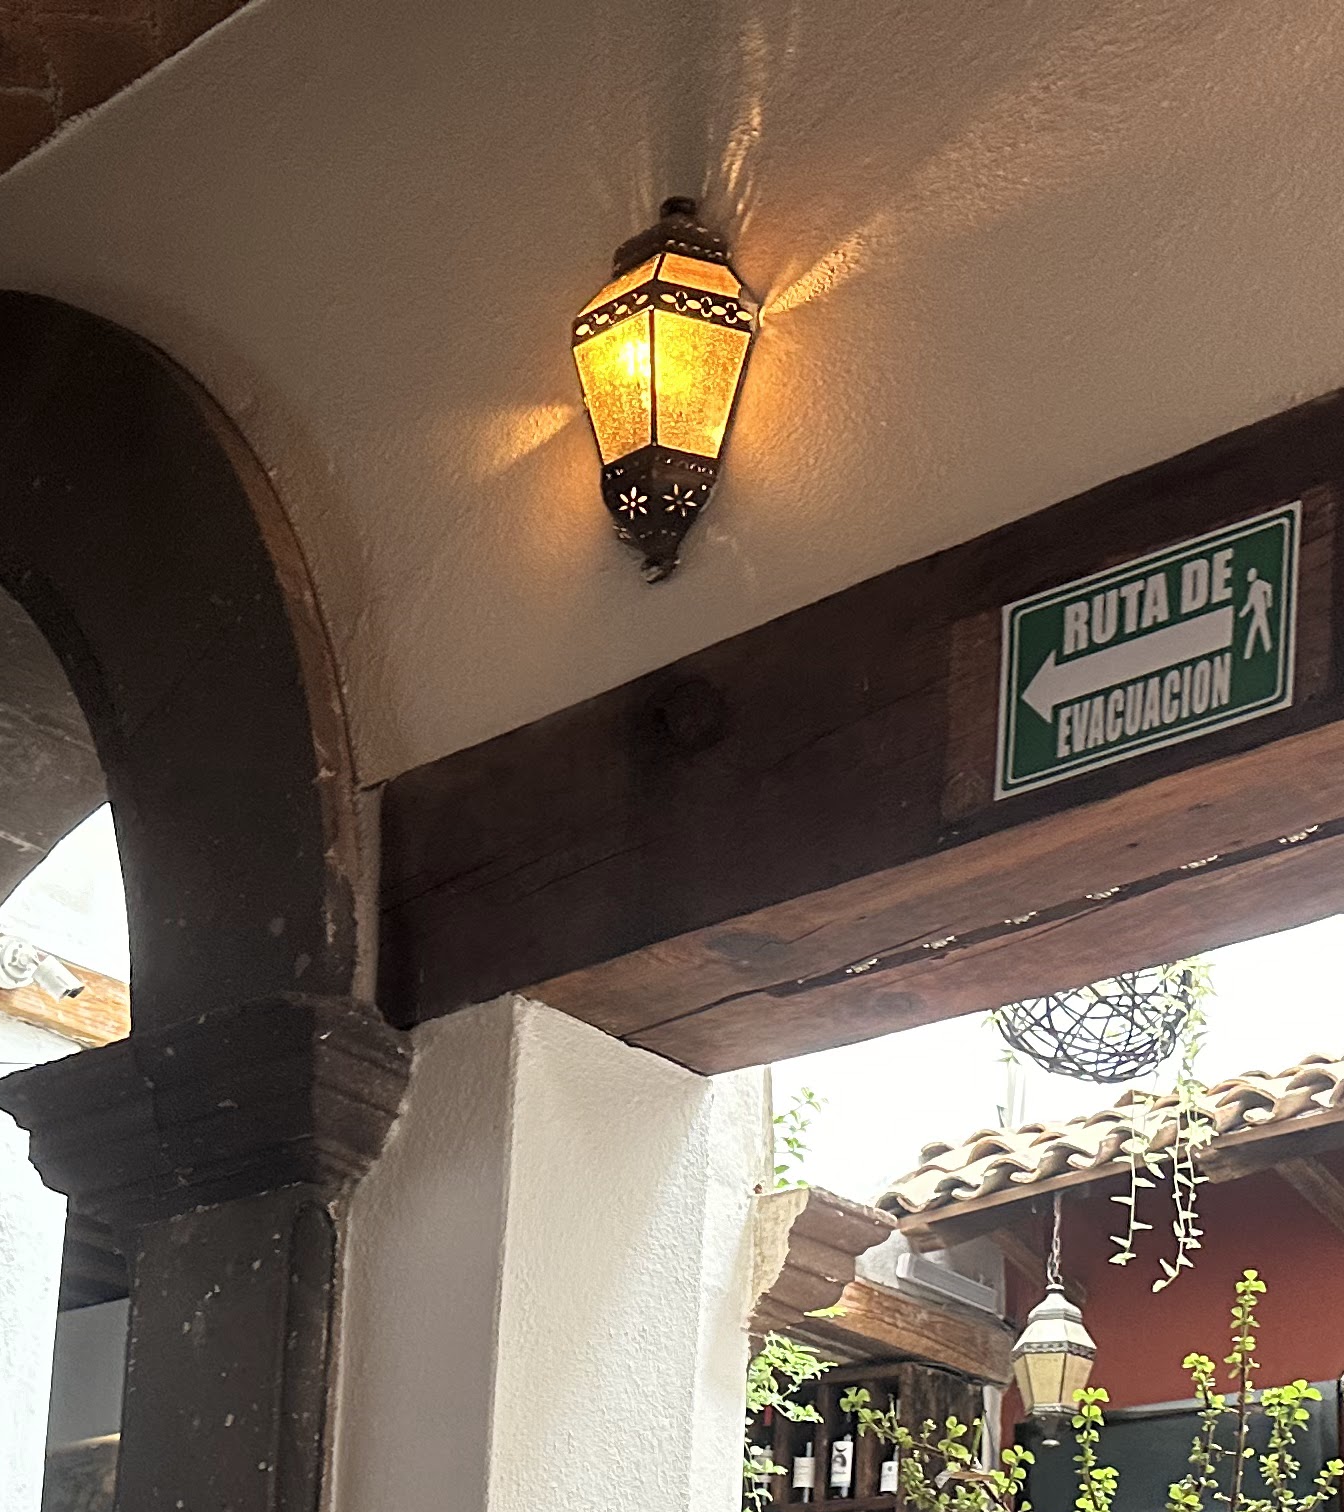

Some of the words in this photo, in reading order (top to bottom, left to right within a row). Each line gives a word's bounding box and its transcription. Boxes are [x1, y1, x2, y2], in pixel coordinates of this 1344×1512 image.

[1063, 572, 1170, 656] RUTA
[1181, 548, 1234, 614] DE
[1056, 652, 1232, 759] EVACUACION
